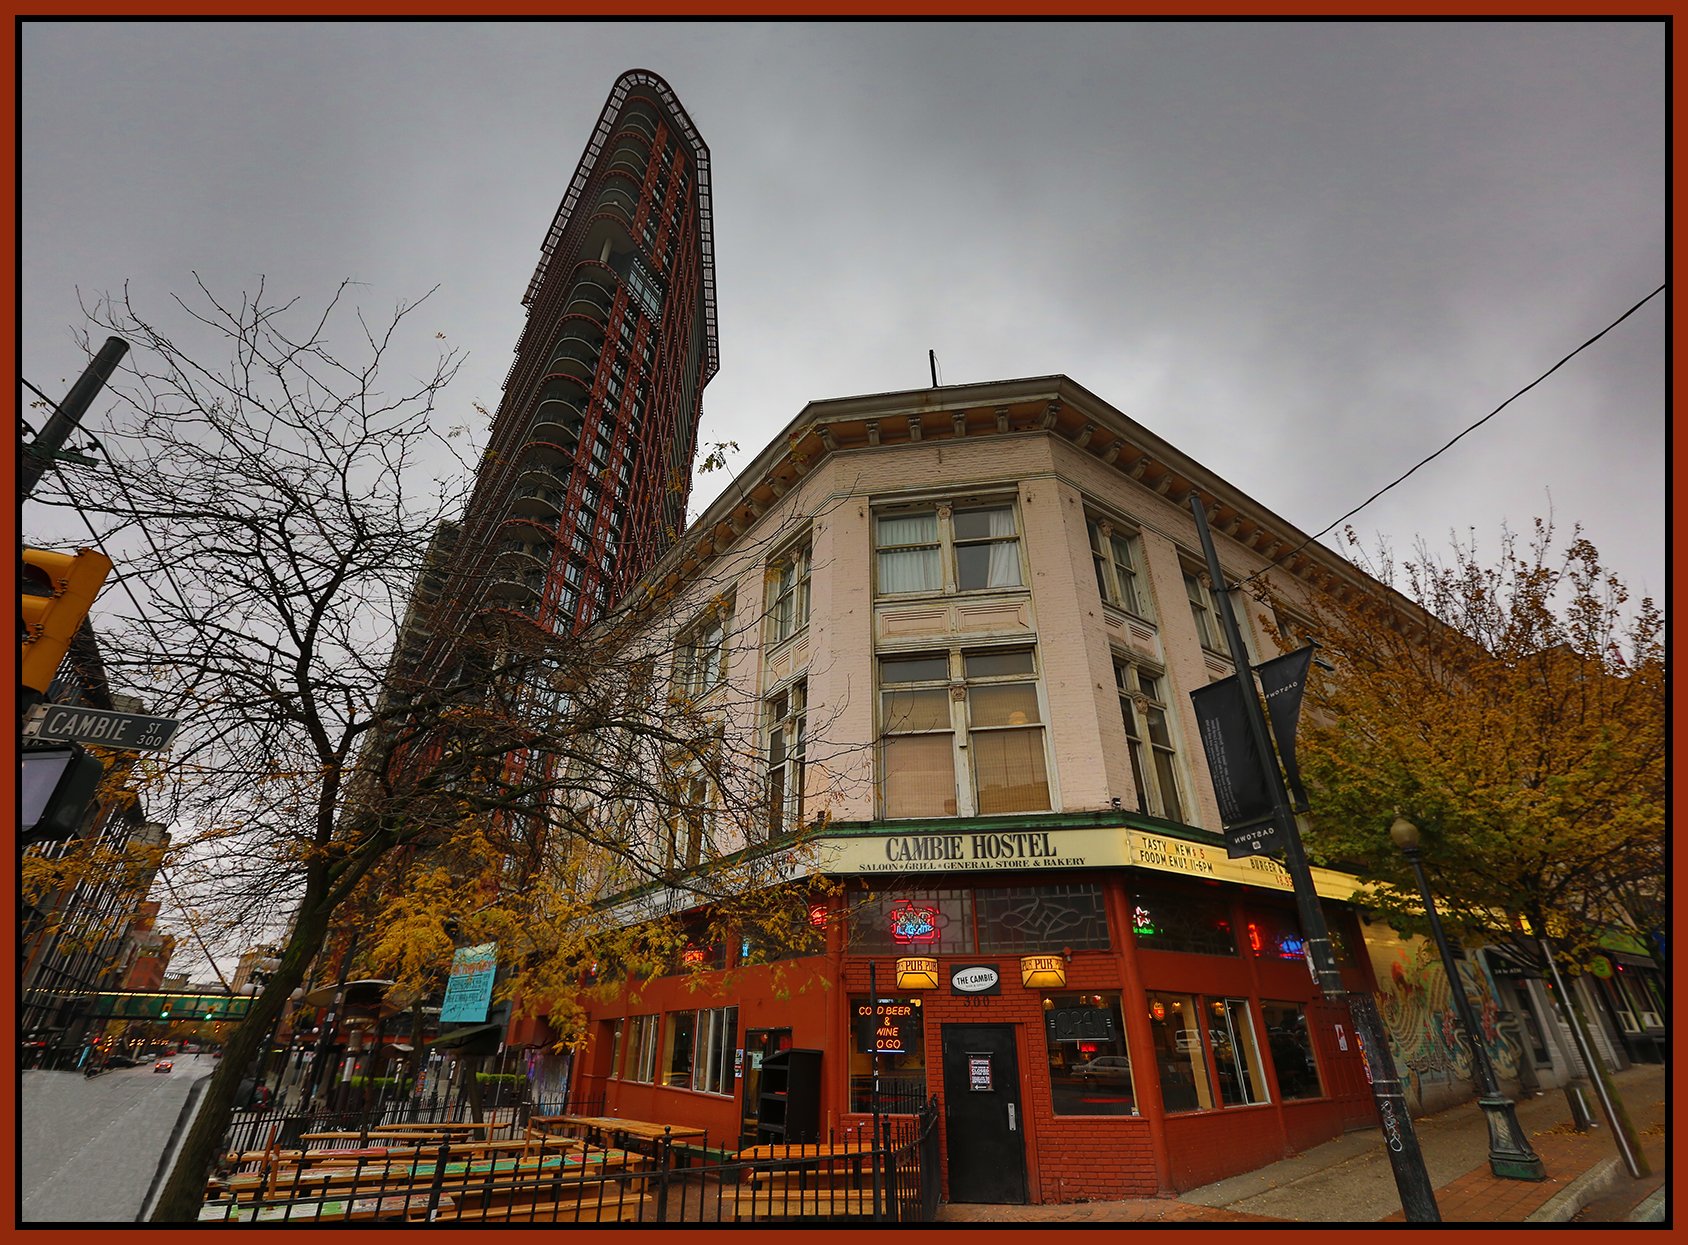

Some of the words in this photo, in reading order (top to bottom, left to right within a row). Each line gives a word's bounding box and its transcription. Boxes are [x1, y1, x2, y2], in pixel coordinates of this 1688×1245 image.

[47, 711, 132, 741] CAMBIE
[146, 722, 162, 734] ST
[136, 734, 162, 747] 300
[885, 835, 964, 862] CAMBIE
[972, 832, 1057, 859] HOSTEL
[1142, 837, 1167, 852] TASTY
[859, 863, 900, 871] SALOON
[905, 862, 936, 871] GRILL
[943, 860, 994, 869] GENERAL
[995, 859, 1030, 868] STORE
[1033, 859, 1040, 867] &
[1043, 857, 1086, 867] BAKERY
[1249, 858, 1277, 872] BURGER
[905, 960, 923, 971] PUB
[1035, 959, 1053, 969] PUB
[957, 976, 969, 985] THE
[970, 973, 994, 984] CAMBIE
[963, 996, 990, 1008] 300
[858, 1006, 884, 1015] COD
[886, 1006, 911, 1015] BEER
[884, 1016, 890, 1026] &
[885, 1039, 901, 1049] GO
